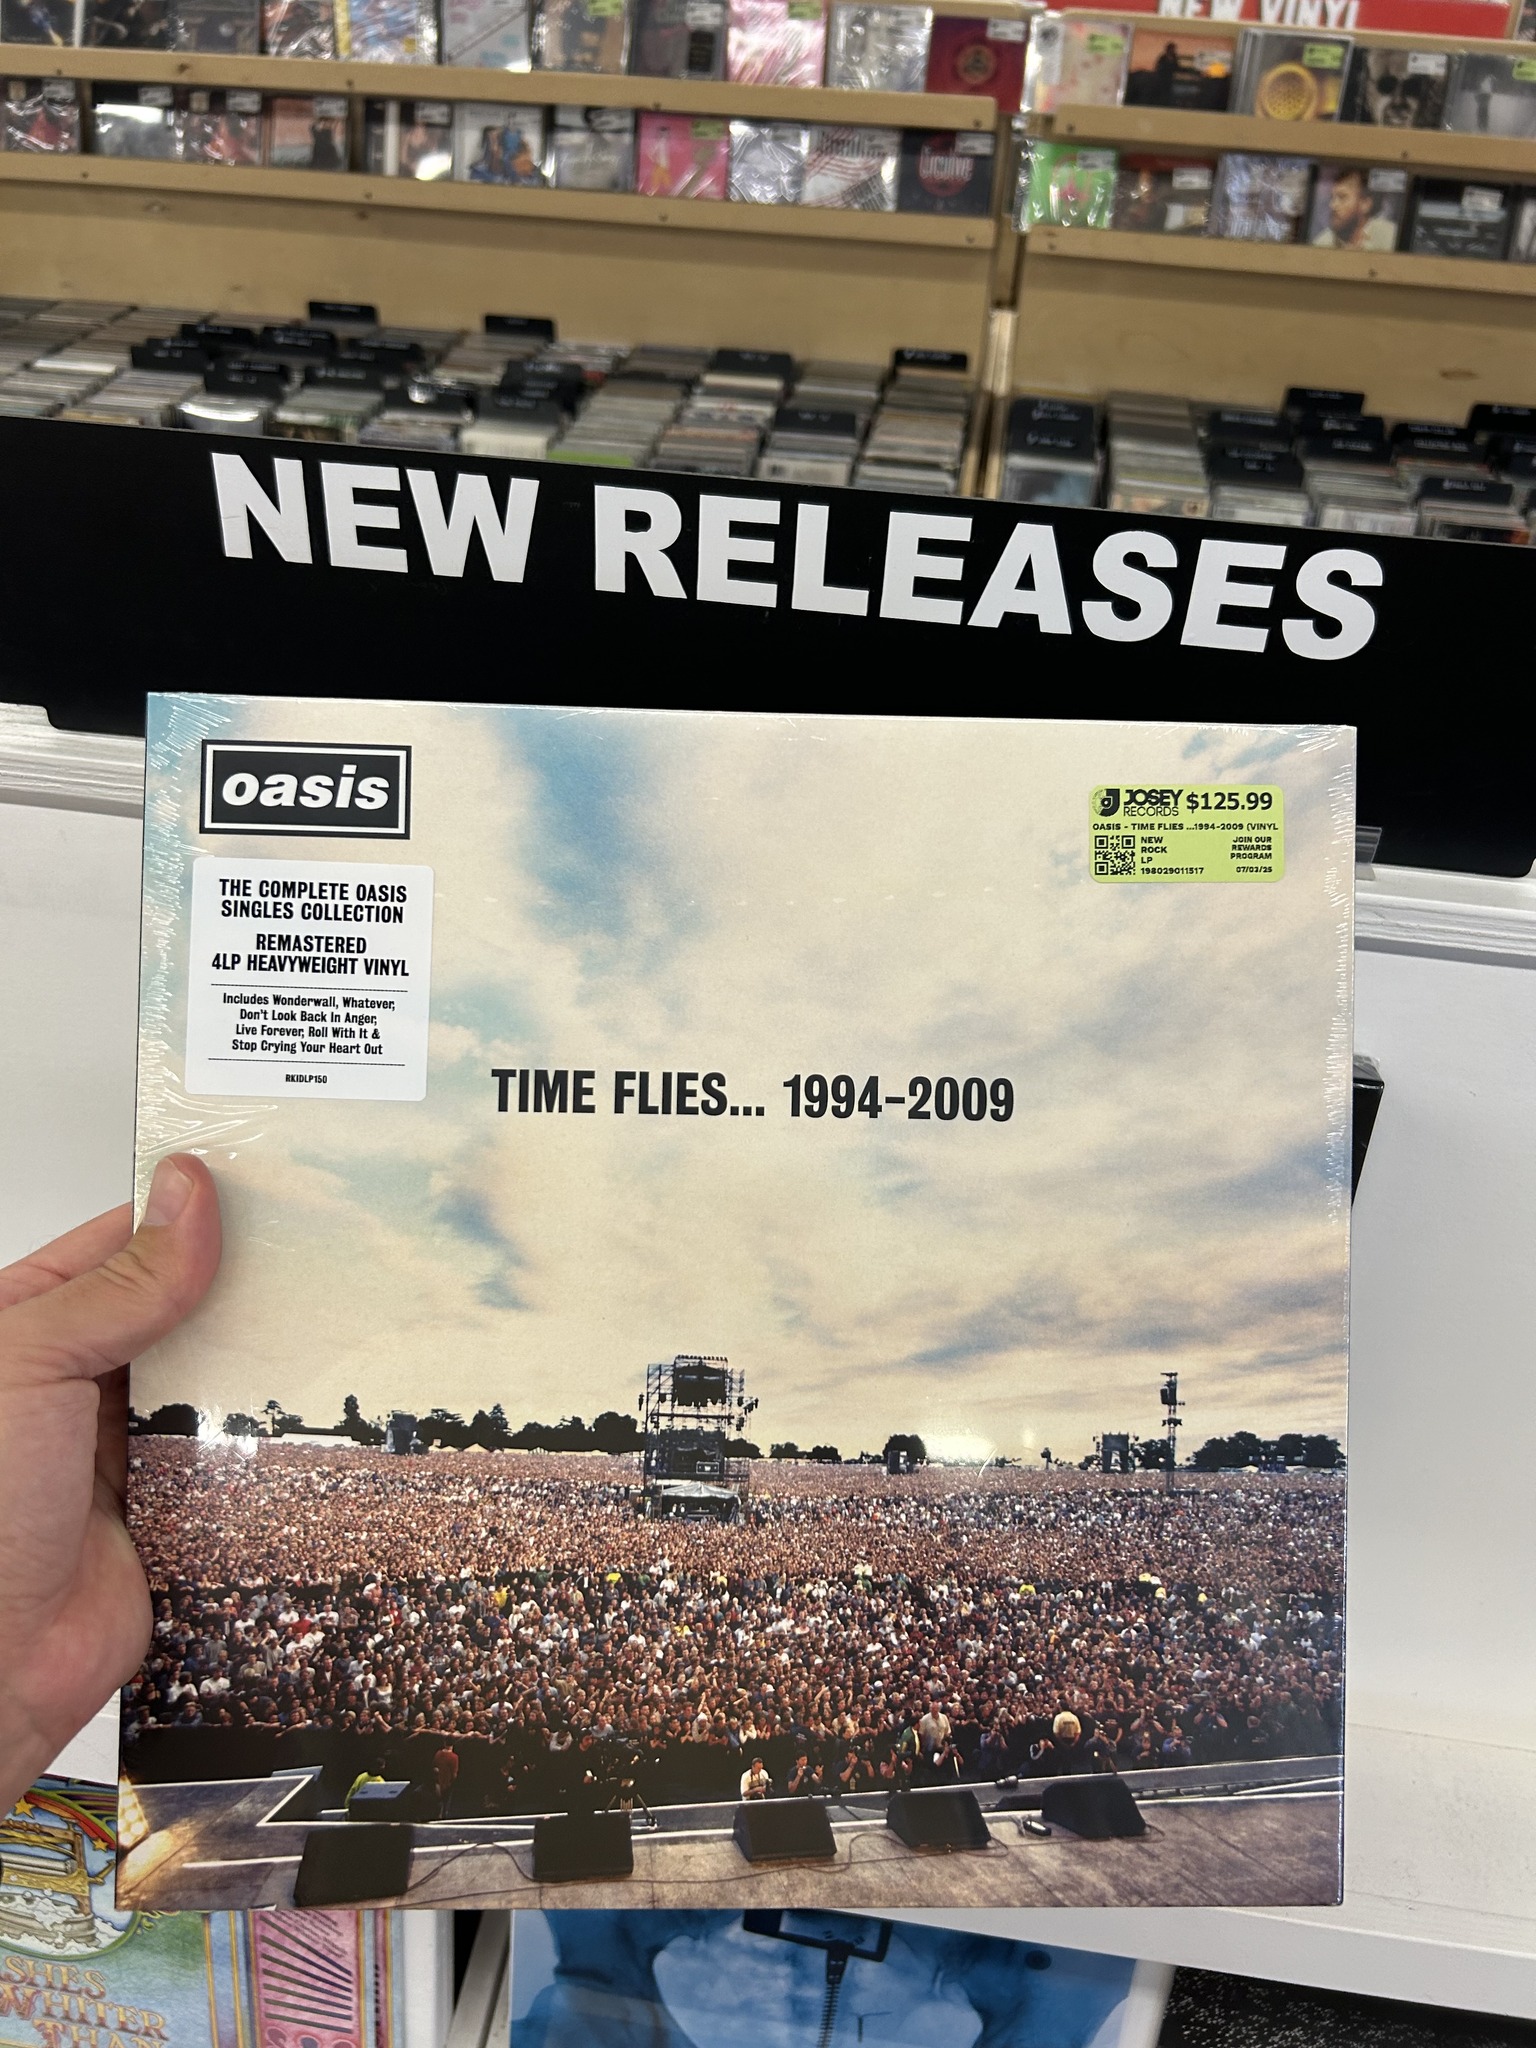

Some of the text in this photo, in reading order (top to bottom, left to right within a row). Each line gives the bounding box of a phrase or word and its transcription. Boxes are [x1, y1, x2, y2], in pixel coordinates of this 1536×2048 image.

[211, 452, 1384, 661] NEW RELEASES
[223, 765, 389, 809] oasis
[1123, 789, 1272, 813] JOSEY $125.99
[1123, 806, 1180, 817] RECORDS
[1092, 823, 1121, 831] OASIS
[1131, 823, 1155, 831] TIME
[1157, 823, 1184, 831] FLIES
[1246, 823, 1279, 832] (VINYL
[1141, 836, 1163, 844] NEW
[1141, 846, 1168, 854] ROCK
[1230, 852, 1272, 860] PROGRAM
[219, 879, 406, 902] THE COMPLETE OASIS
[222, 900, 403, 923] SINGLES COLLECTION
[256, 934, 366, 953] REMASTERED
[212, 953, 409, 976] 4LP HEAVYWEIGHT VINYL
[223, 992, 396, 1012] Includes Wonderwall, Whatever,
[240, 1008, 377, 1026] Don't Look Back In Anger,
[235, 1023, 381, 1040] Live Forever, Roll With It &
[232, 1038, 383, 1055] Stop Crying Your Heart Out
[285, 1073, 328, 1084] RKIDLP150
[491, 1069, 1014, 1122] TIME FLIES... 1994-2009
